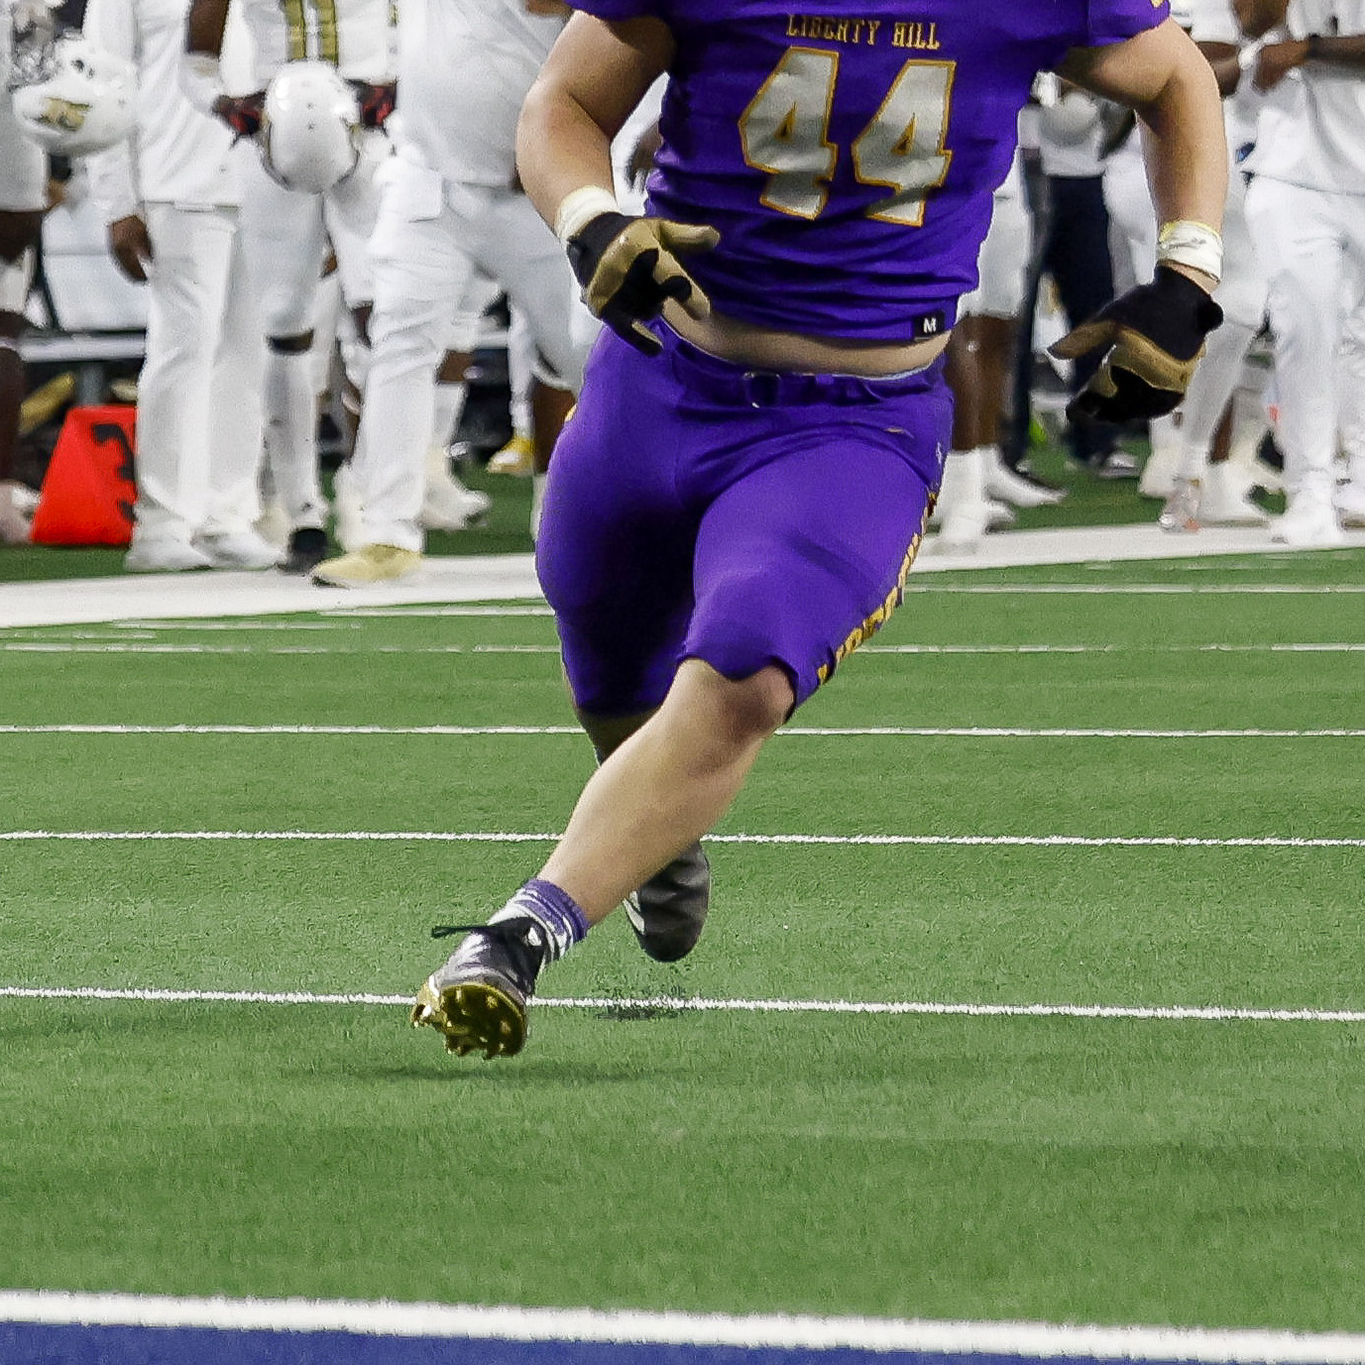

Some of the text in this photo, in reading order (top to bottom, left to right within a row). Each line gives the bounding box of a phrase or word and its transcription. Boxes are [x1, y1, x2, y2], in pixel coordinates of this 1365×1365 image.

[890, 21, 941, 51] HILL
[737, 45, 958, 228] 44
[922, 316, 937, 334] M
